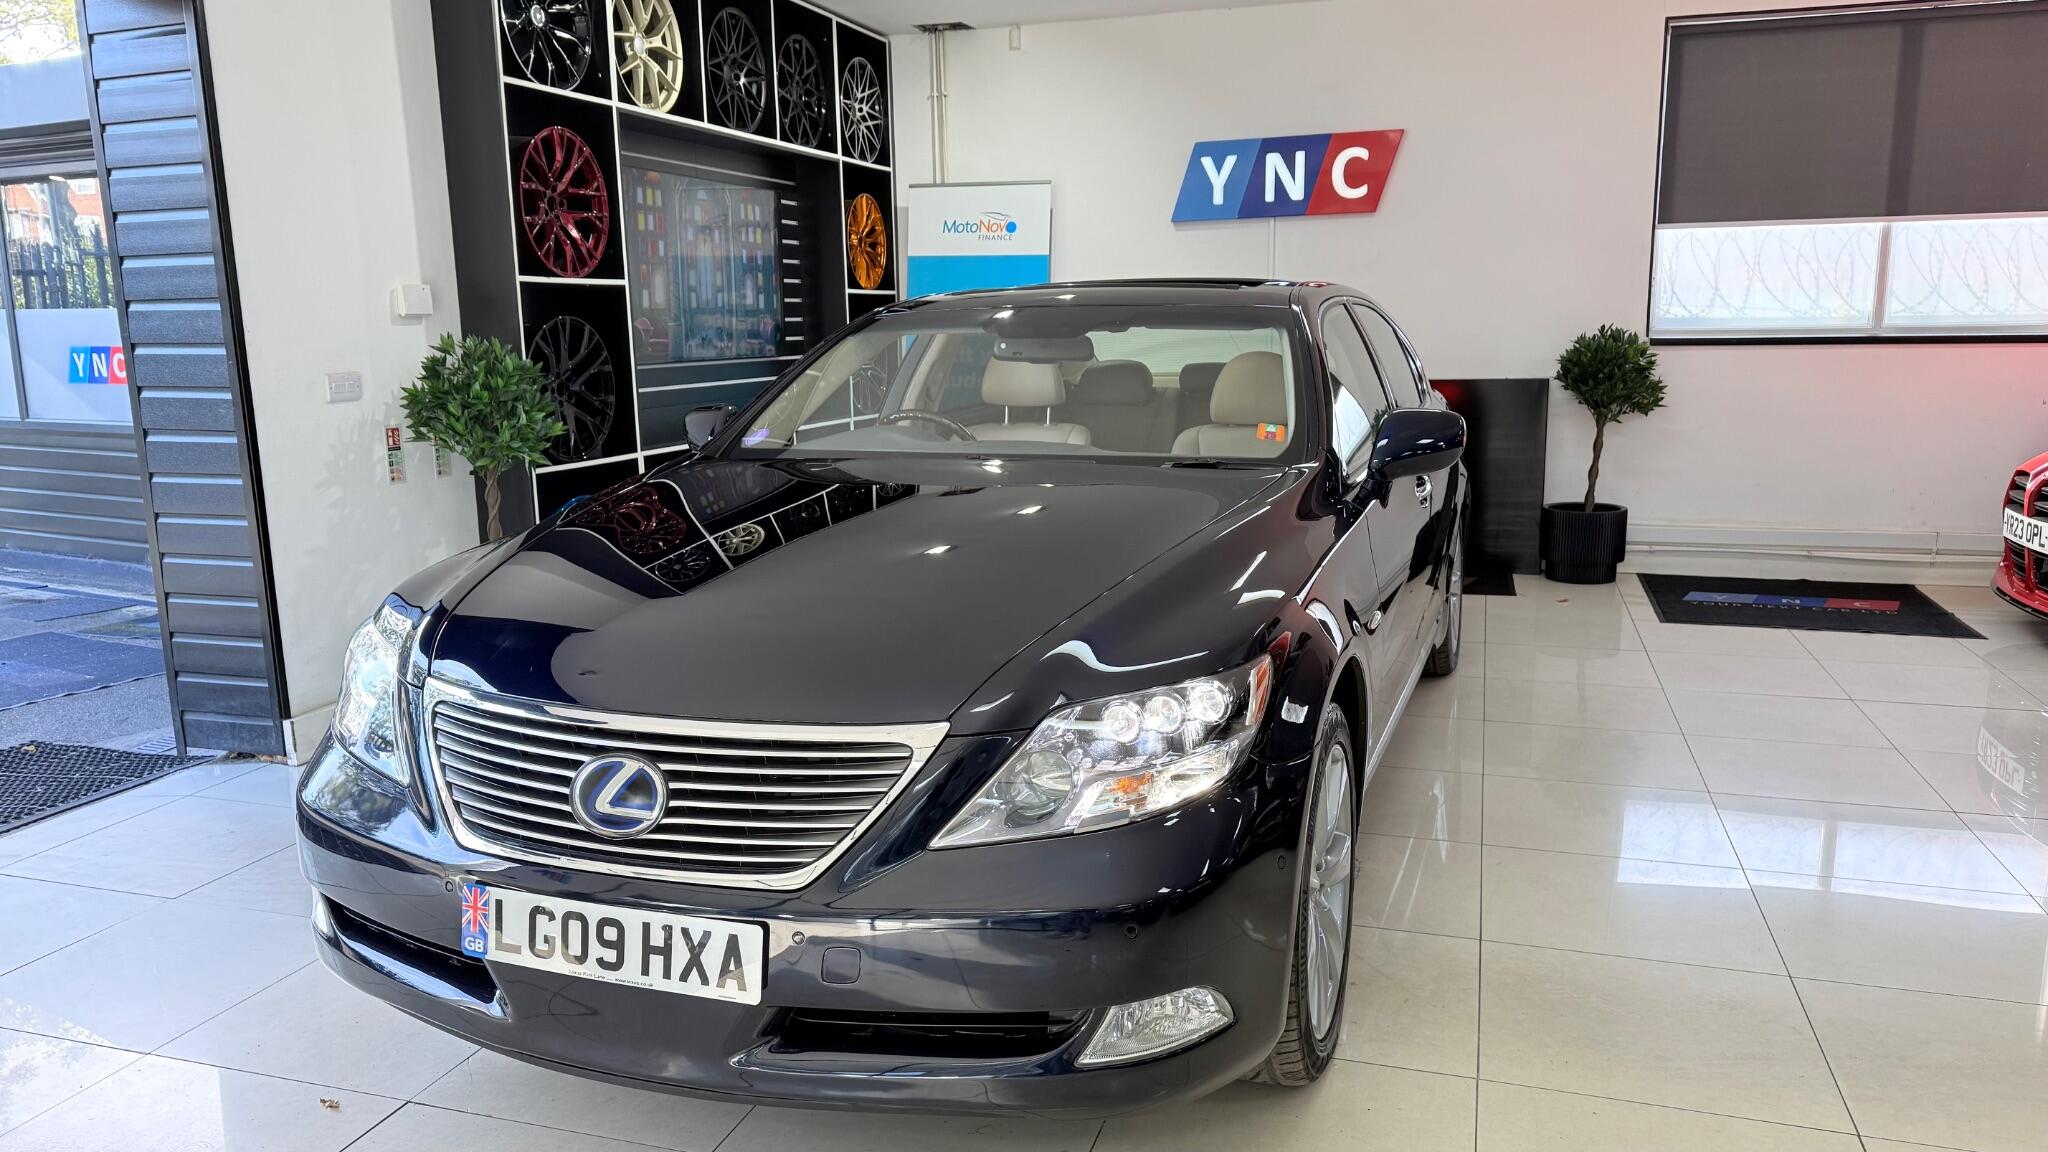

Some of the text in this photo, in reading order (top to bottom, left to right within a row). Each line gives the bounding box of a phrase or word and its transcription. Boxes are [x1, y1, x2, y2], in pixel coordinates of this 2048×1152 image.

[1201, 146, 1370, 206] YNC
[978, 233, 1013, 241] FINANCE
[2025, 522, 2046, 548] OPL
[464, 936, 485, 952] GB
[494, 898, 748, 993] LG09 HXA
